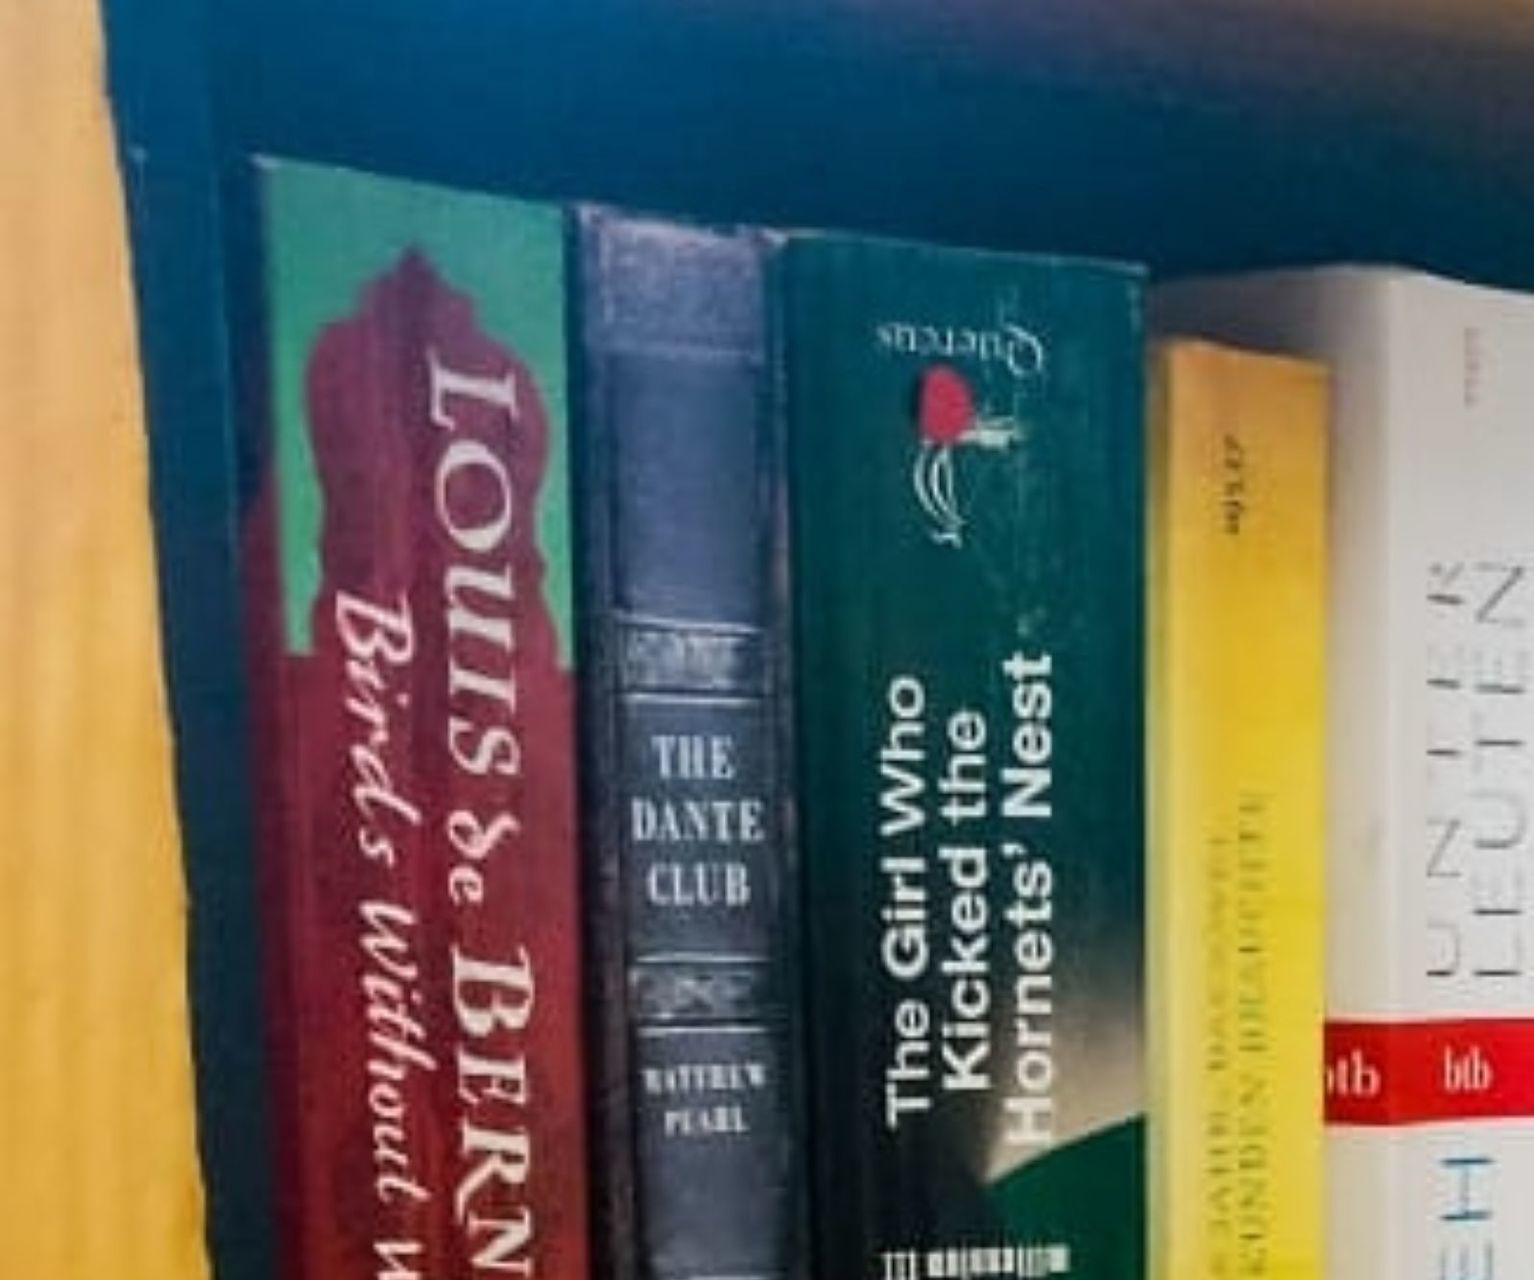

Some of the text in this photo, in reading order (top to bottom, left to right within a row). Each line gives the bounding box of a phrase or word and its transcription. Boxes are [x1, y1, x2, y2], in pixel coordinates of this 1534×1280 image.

[874, 324, 1044, 378] Quercus
[428, 352, 522, 777] LOUIS
[335, 592, 419, 868] Birds
[653, 734, 733, 781] THE
[1003, 652, 1053, 816] Nest
[1472, 563, 1527, 978] LEUTEN
[449, 807, 518, 904] de
[632, 799, 764, 844] DANTE
[647, 861, 751, 906] CLUB
[880, 675, 928, 1127] The Girl Who
[939, 710, 989, 1093] Kicked the
[349, 897, 436, 1203] Without
[644, 1062, 767, 1097] MATTHEW
[1444, 1045, 1492, 1091] btb
[664, 1102, 747, 1135] PEARL
